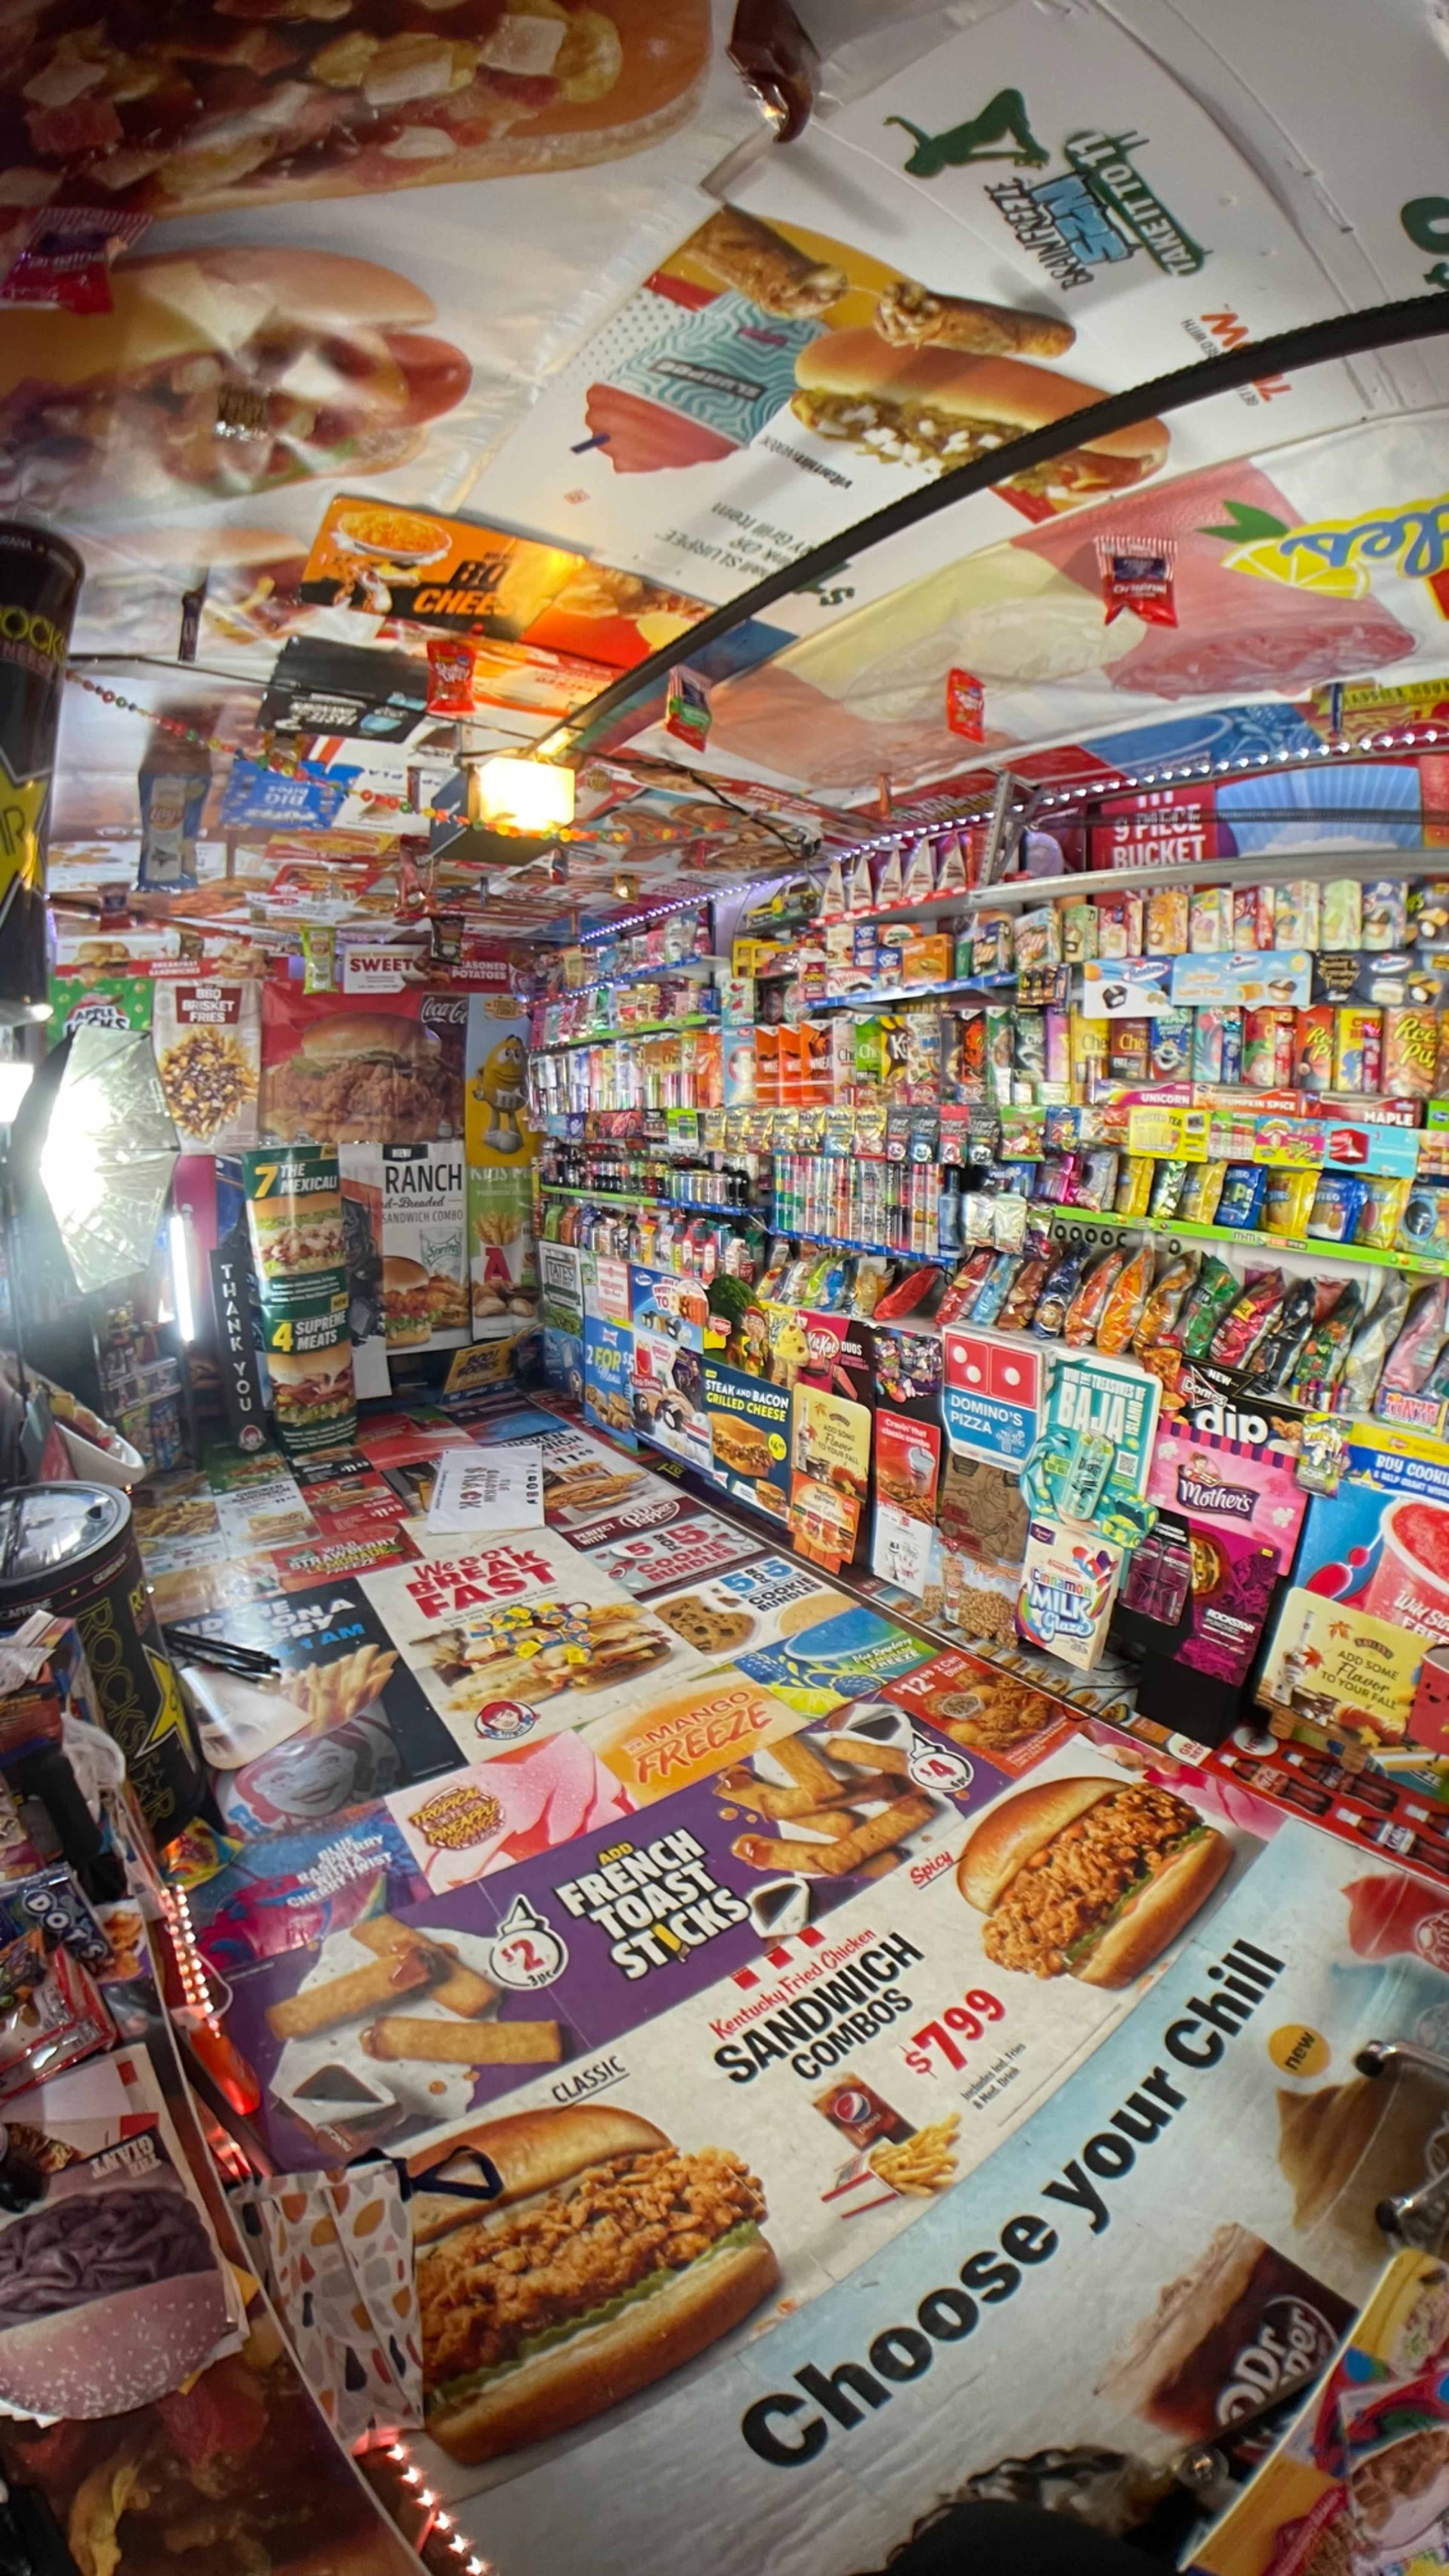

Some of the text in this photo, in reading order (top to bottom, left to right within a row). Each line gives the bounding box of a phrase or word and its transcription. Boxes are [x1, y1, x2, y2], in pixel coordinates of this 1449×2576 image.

[1100, 163, 1143, 200] TO
[1122, 196, 1157, 226] IT
[983, 175, 1094, 291] BRAINFREEZE
[1139, 217, 1197, 275] TAKE
[711, 501, 751, 534] Item
[1112, 835, 1206, 869] BUCKET
[349, 957, 414, 973] SWEET
[452, 968, 508, 980] POTATOES
[182, 999, 235, 1011] BRISKET
[196, 988, 222, 1000] BBQ
[189, 1011, 226, 1023] FRIES
[1140, 1093, 1190, 1105] UNICORN
[1266, 1100, 1296, 1112] SPICE
[1363, 1109, 1415, 1127] MAPLE
[254, 1163, 306, 1198] 7 THE
[280, 1175, 338, 1194] MEXICALI
[385, 1163, 463, 1195] RANCH
[382, 1209, 463, 1225] SANDWICH COMBO
[220, 1264, 252, 1412] THANK YOU
[272, 1312, 346, 1352] 4 SUPREME
[297, 1331, 338, 1352] MEATS
[585, 1346, 593, 1365] 2
[594, 1347, 621, 1372] FOR
[841, 1342, 863, 1356] DUOS
[1182, 1379, 1227, 1407] Doritos
[1208, 1369, 1231, 1387] NEW
[705, 1380, 790, 1410] STEAK AND BACON
[706, 1392, 787, 1422] GRILLED CHEESE
[950, 1395, 1024, 1427] DOMINO'S
[950, 1409, 993, 1435] PIZZA
[1057, 1380, 1144, 1445] BAJA ISLAND
[1196, 1404, 1269, 1444] dip
[823, 1424, 838, 1436] ADD
[824, 1434, 854, 1452] Flavor
[881, 1427, 931, 1449] classic combo
[1375, 1454, 1405, 1473] BUY
[1181, 1479, 1252, 1513] Mother's
[572, 1523, 616, 1542] PERFECT
[581, 1534, 608, 1547] WITH
[624, 1524, 710, 1557] 5 FOR 5
[288, 1536, 398, 1570] STRAWBERRY
[306, 1548, 390, 1574] LEMONADE
[413, 1545, 514, 1582] We GOT
[637, 1540, 731, 1573] COOKIE
[646, 1547, 739, 1583] BUNDLES
[405, 1550, 550, 1598] BREAK
[717, 1558, 793, 1593] 5 FOR 5
[1030, 1567, 1097, 1598] Cinnamon
[414, 1561, 557, 1620] FAST
[747, 1576, 818, 1607] COOKIE
[757, 1583, 823, 1613] BUNDLES
[1029, 1586, 1094, 1620] MILK
[1041, 1612, 1095, 1644] Glaze
[869, 1650, 921, 1670] FREEZE
[1337, 1650, 1400, 1681] ADD SOME
[1321, 1671, 1399, 1710] TO YOUR FALL
[1337, 1663, 1392, 1693] Flavor
[645, 1689, 753, 1744] MANGO
[635, 1699, 774, 1785] FREEZE
[412, 1786, 480, 1824] TROPICAL
[428, 1796, 500, 1844] PINEAPPLE
[447, 1814, 498, 1846] ORANGE
[317, 1835, 355, 1861] BLUE
[598, 1841, 634, 1866] ADD
[286, 1852, 393, 1908] CHERRY TWIST
[556, 1829, 708, 1917] FRENCH
[909, 1847, 955, 1888] Spicy
[590, 1860, 717, 1940] TOAST
[610, 1890, 751, 1980] STICKS
[708, 1927, 877, 2042] Kentucky Fried Chicken
[713, 1932, 926, 2084] SANDWICH
[790, 1987, 914, 2080] COMBOS
[1004, 2041, 1028, 2063] Fries
[1284, 2030, 1316, 2071] new
[552, 2055, 628, 2104] CLASSIC
[997, 2065, 1022, 2090] Drink
[741, 1938, 1286, 2468] Choose your Chill
[1234, 2324, 1287, 2395] Dr
